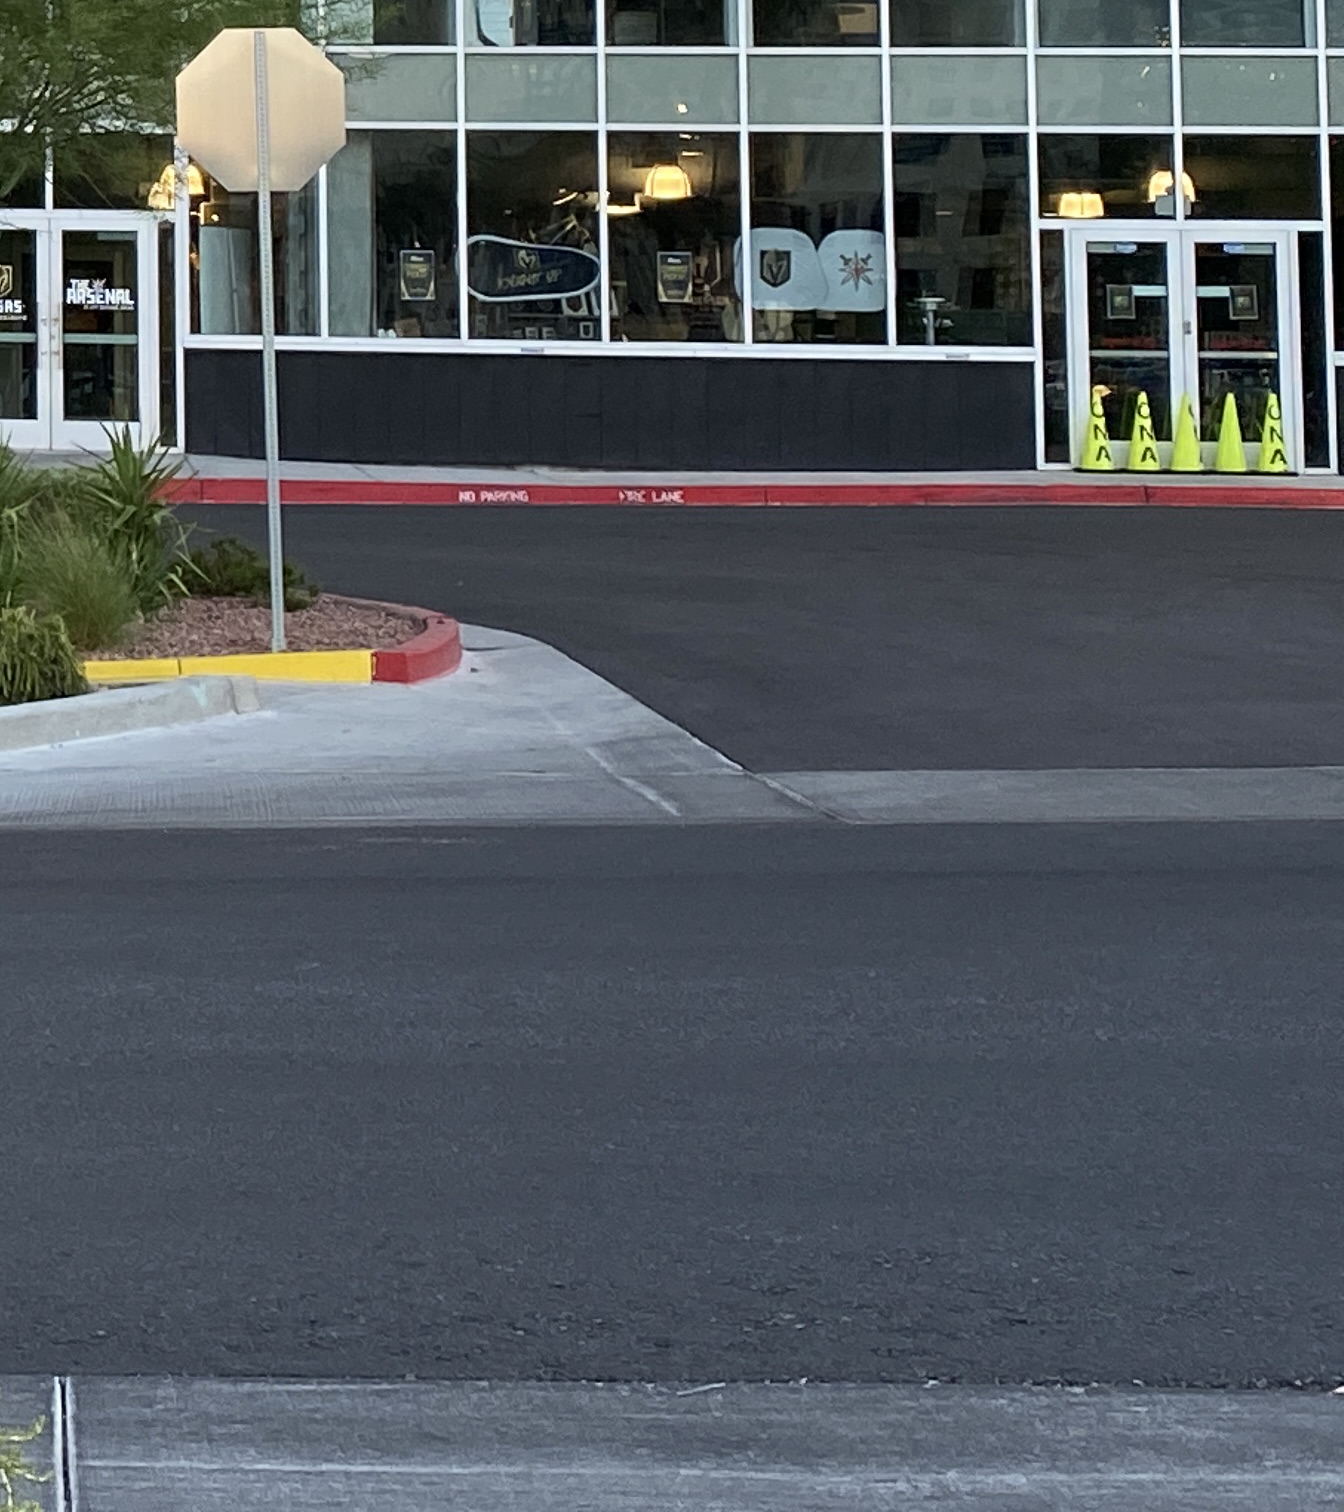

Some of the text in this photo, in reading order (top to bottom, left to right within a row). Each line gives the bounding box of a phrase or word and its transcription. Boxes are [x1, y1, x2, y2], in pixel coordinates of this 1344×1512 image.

[66, 288, 135, 305] ARSENAL
[458, 490, 529, 504] NO PARKING
[651, 490, 685, 504] LANE
